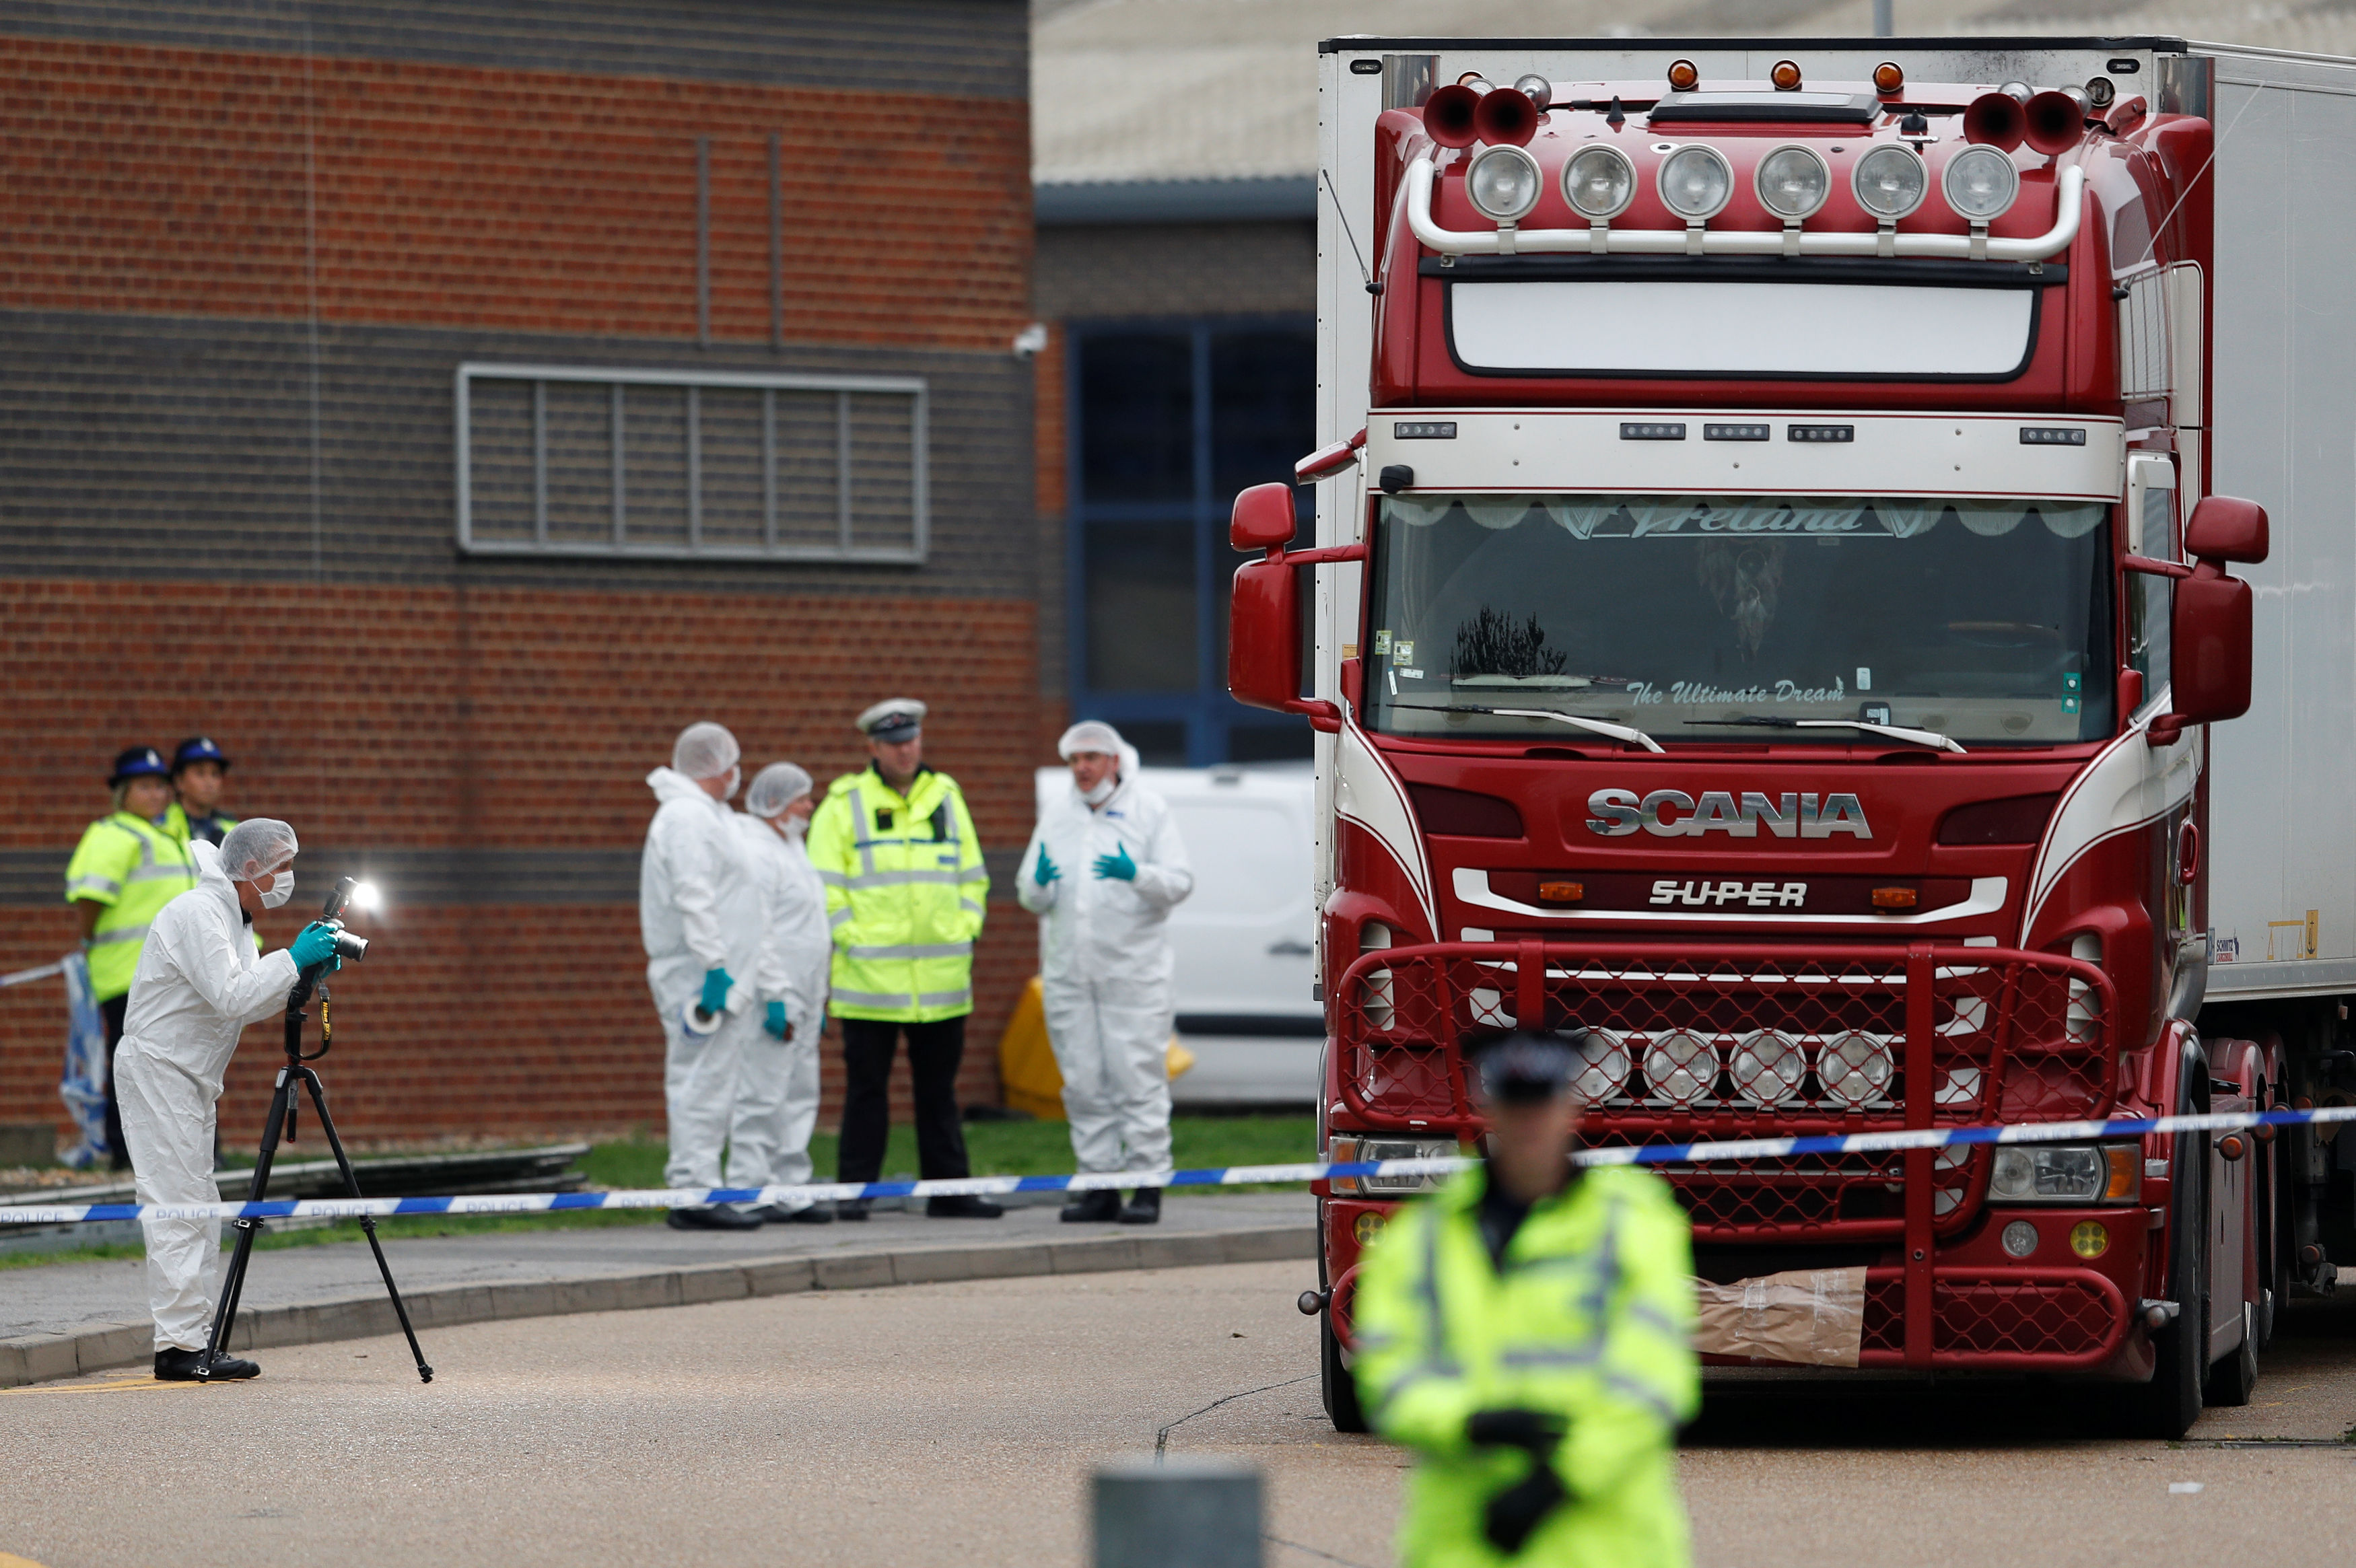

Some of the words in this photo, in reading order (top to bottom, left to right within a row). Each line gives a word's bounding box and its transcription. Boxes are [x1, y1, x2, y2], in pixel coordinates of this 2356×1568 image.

[1612, 499, 1863, 538] Ireland
[1626, 681, 1663, 706] The
[1670, 681, 1767, 705] Ultimate
[1774, 679, 1845, 703] Dream
[1585, 788, 1874, 839] SCANIA
[1649, 880, 1808, 908] SUPER
[156, 1207, 219, 1219] POLICE
[312, 1203, 375, 1217] POLICE
[466, 1200, 528, 1213] POLICE
